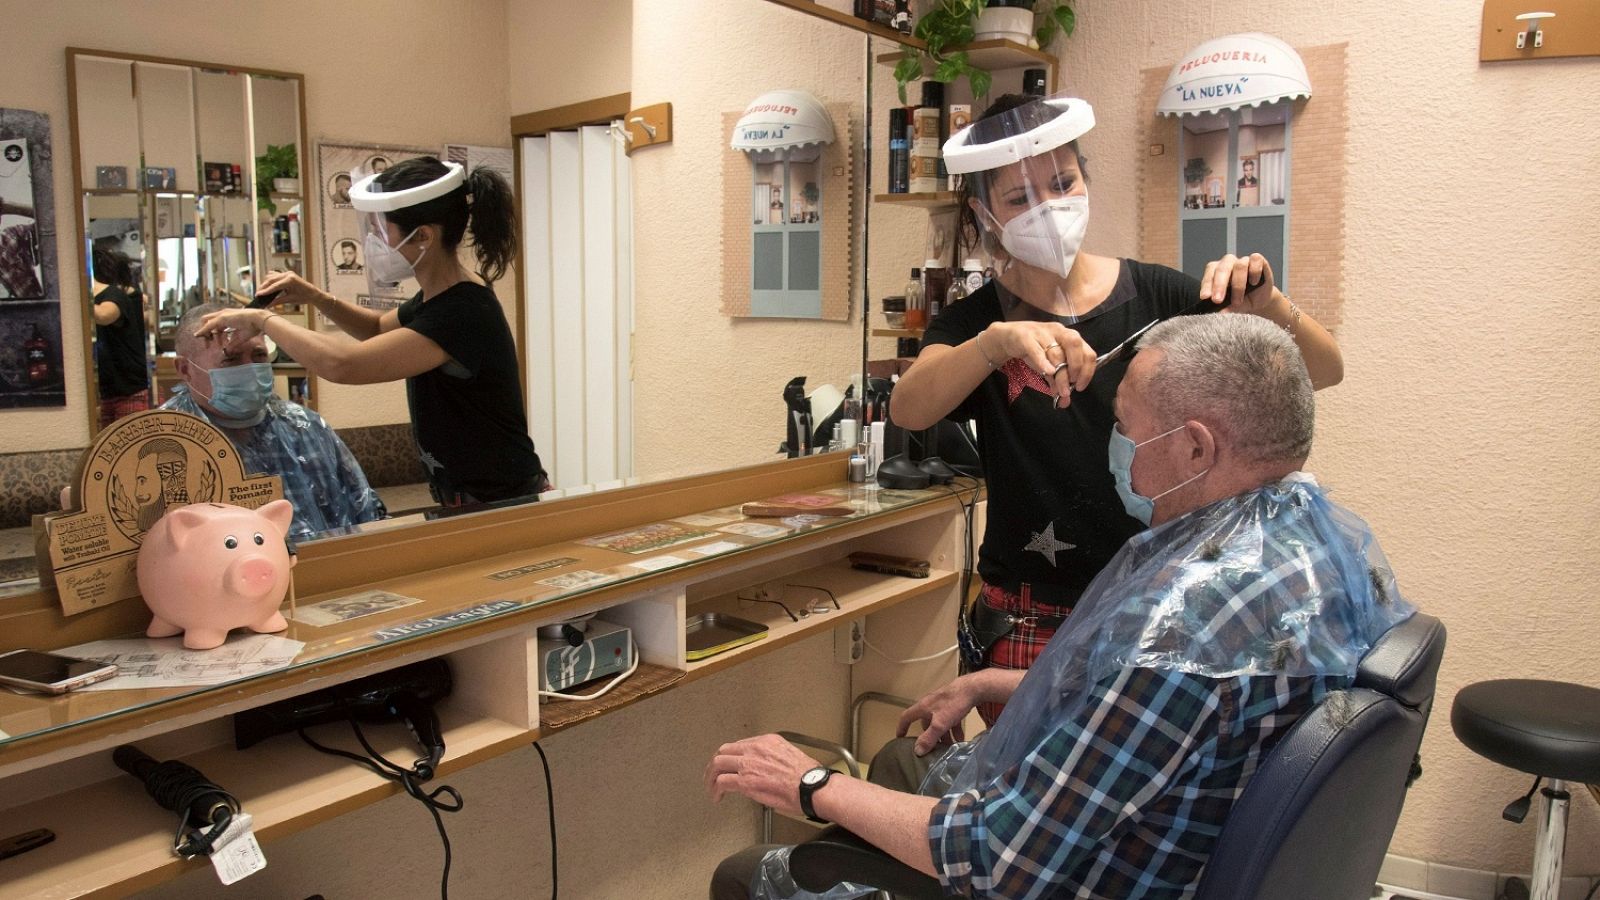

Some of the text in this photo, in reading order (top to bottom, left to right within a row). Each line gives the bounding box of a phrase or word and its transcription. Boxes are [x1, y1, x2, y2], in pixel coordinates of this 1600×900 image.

[98, 417, 215, 464] BARBER MIND
[228, 482, 273, 494] The first
[229, 489, 273, 502] Pomade
[58, 525, 107, 547] POMADE
[60, 538, 110, 556] Water soluble
